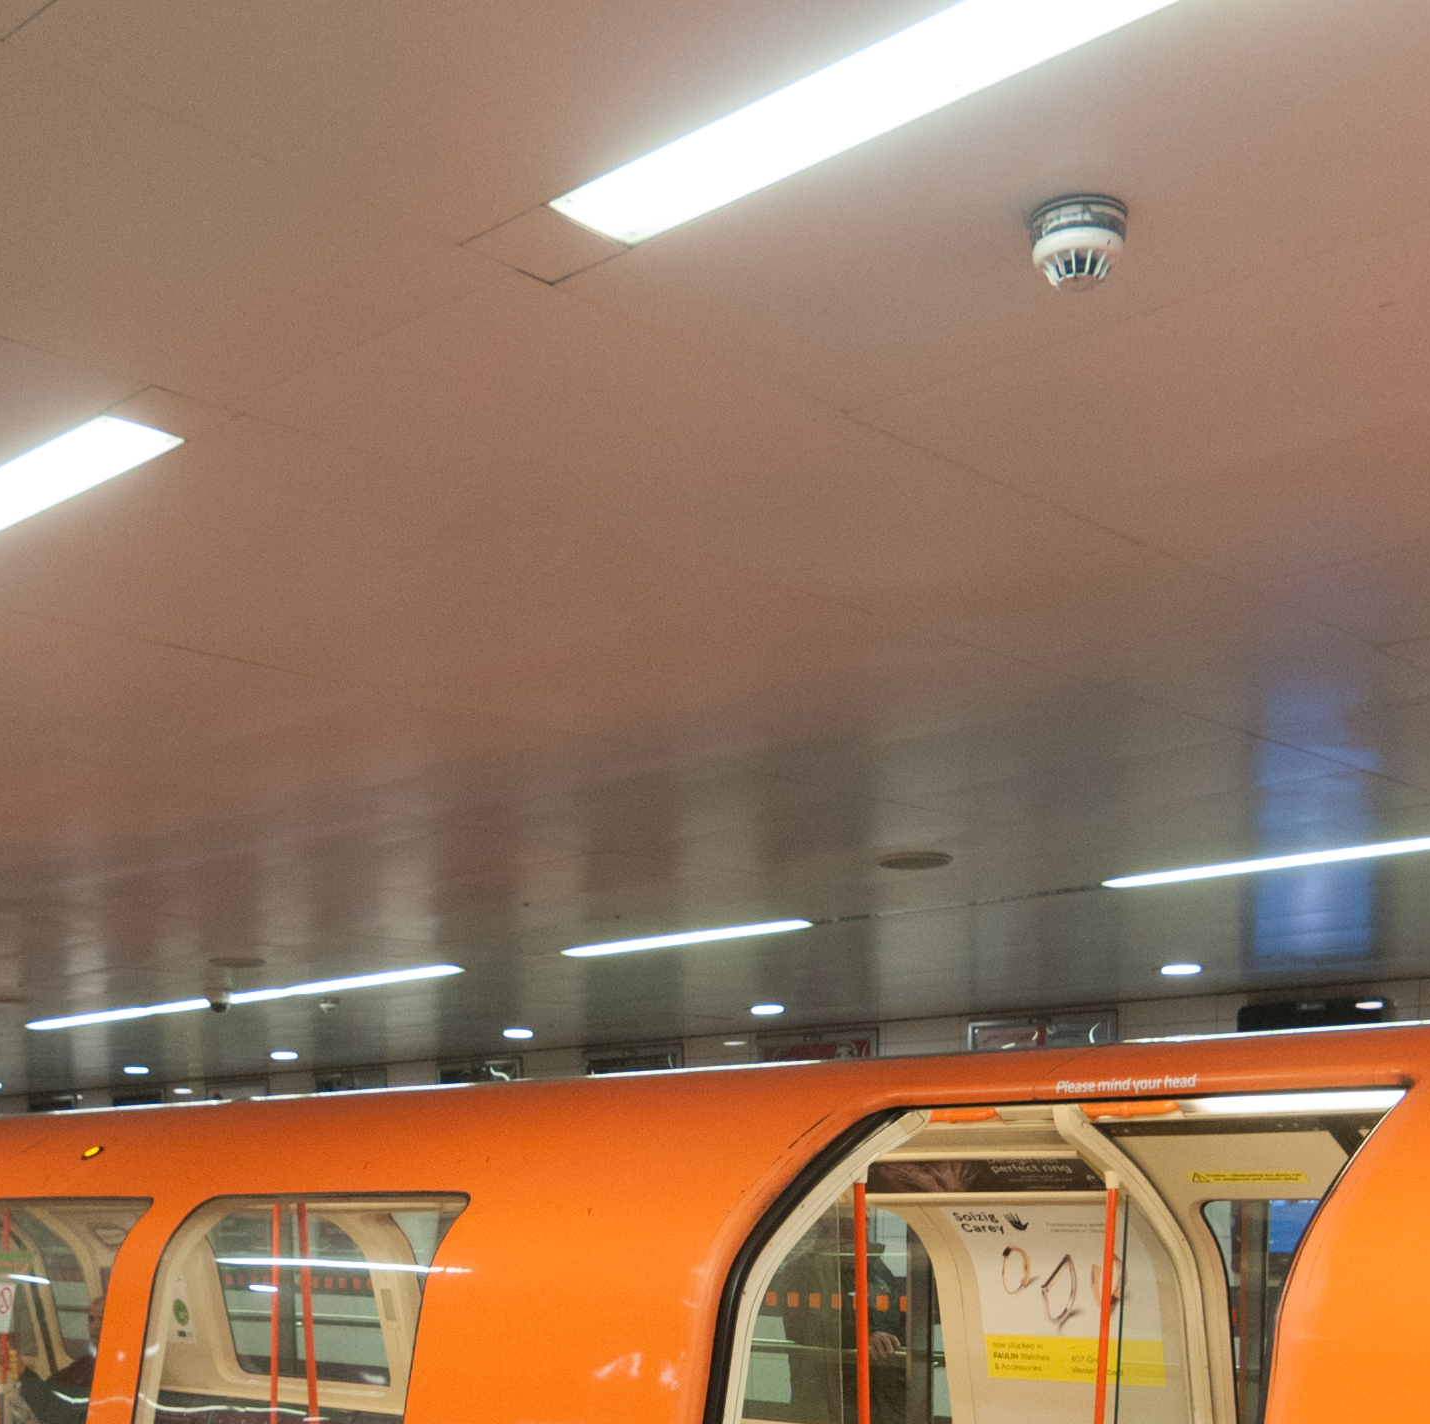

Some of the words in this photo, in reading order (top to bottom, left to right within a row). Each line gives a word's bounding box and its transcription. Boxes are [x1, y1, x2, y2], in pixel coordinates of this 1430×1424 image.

[1056, 1080, 1096, 1094] Please
[1098, 1077, 1131, 1092] mind
[1133, 1079, 1162, 1094] your
[1164, 1073, 1197, 1089] head
[990, 1164, 1041, 1175] perfect
[1043, 1164, 1073, 1174] ring
[961, 1222, 1005, 1235] Carey
